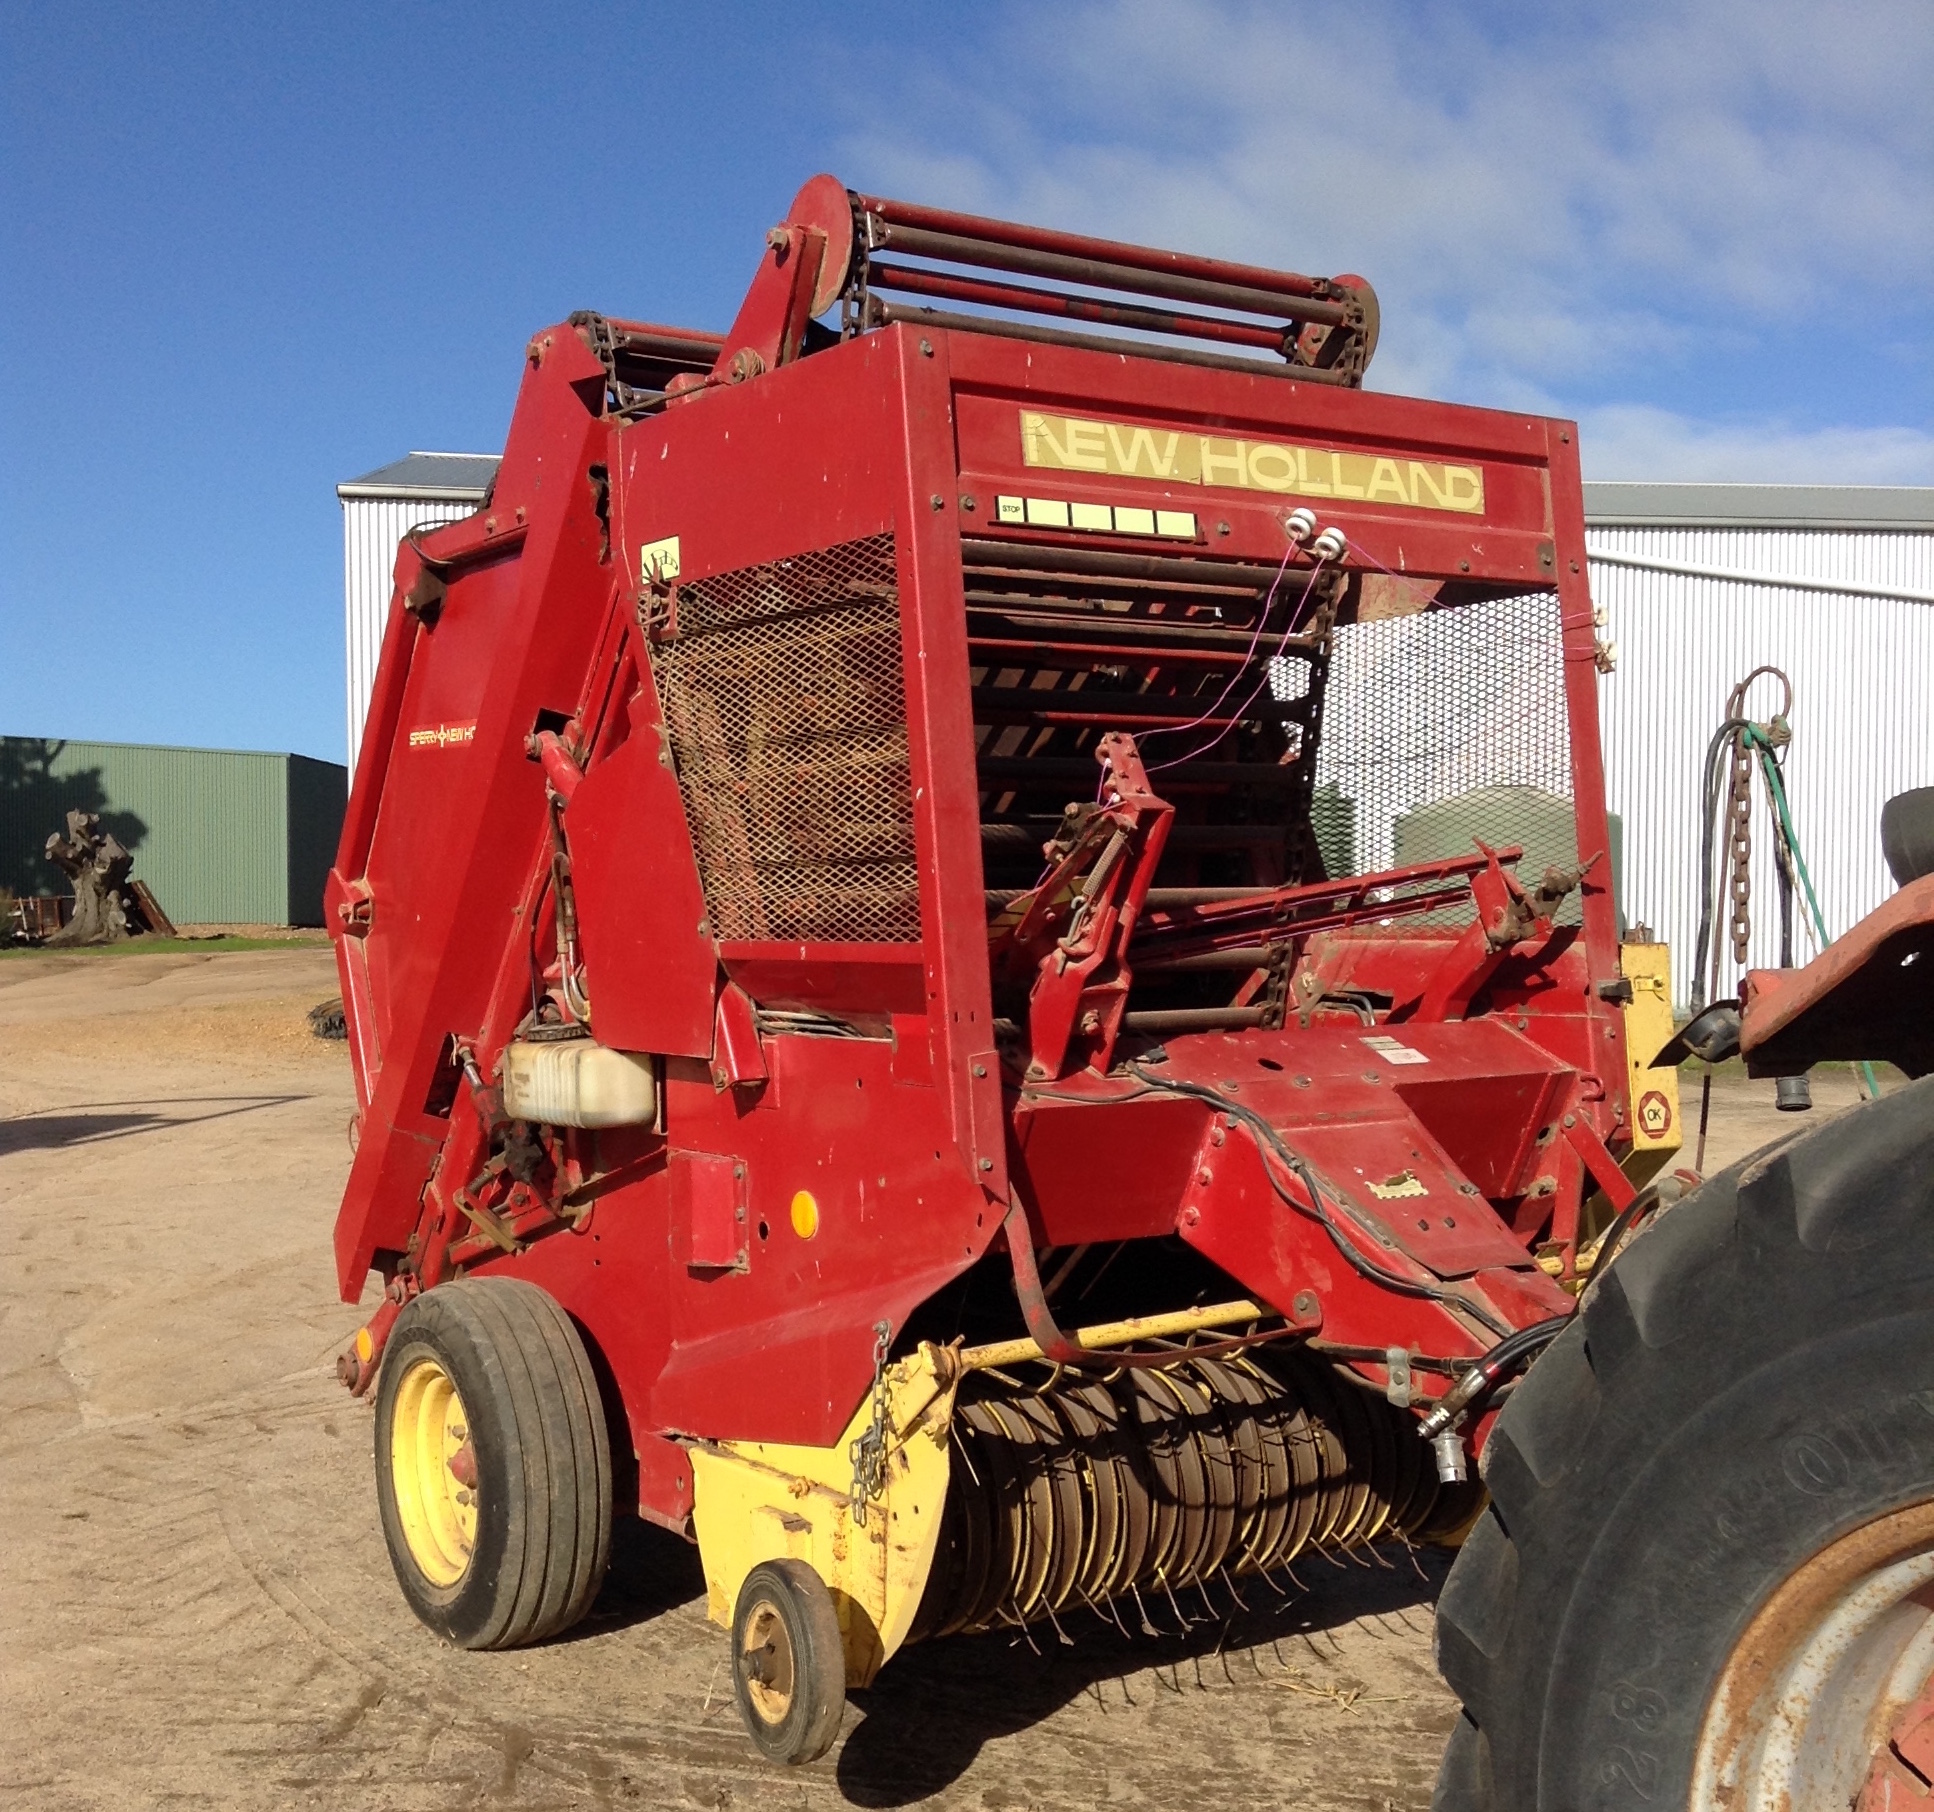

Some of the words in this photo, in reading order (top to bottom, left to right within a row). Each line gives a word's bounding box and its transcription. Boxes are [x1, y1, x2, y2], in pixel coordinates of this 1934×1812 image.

[1025, 412, 1180, 476] NEW
[1202, 439, 1480, 511] HOLLAND
[1002, 504, 1021, 513] STOP
[409, 730, 438, 746] SPERRY
[446, 728, 464, 742] NEW
[1647, 1108, 1662, 1121] OK
